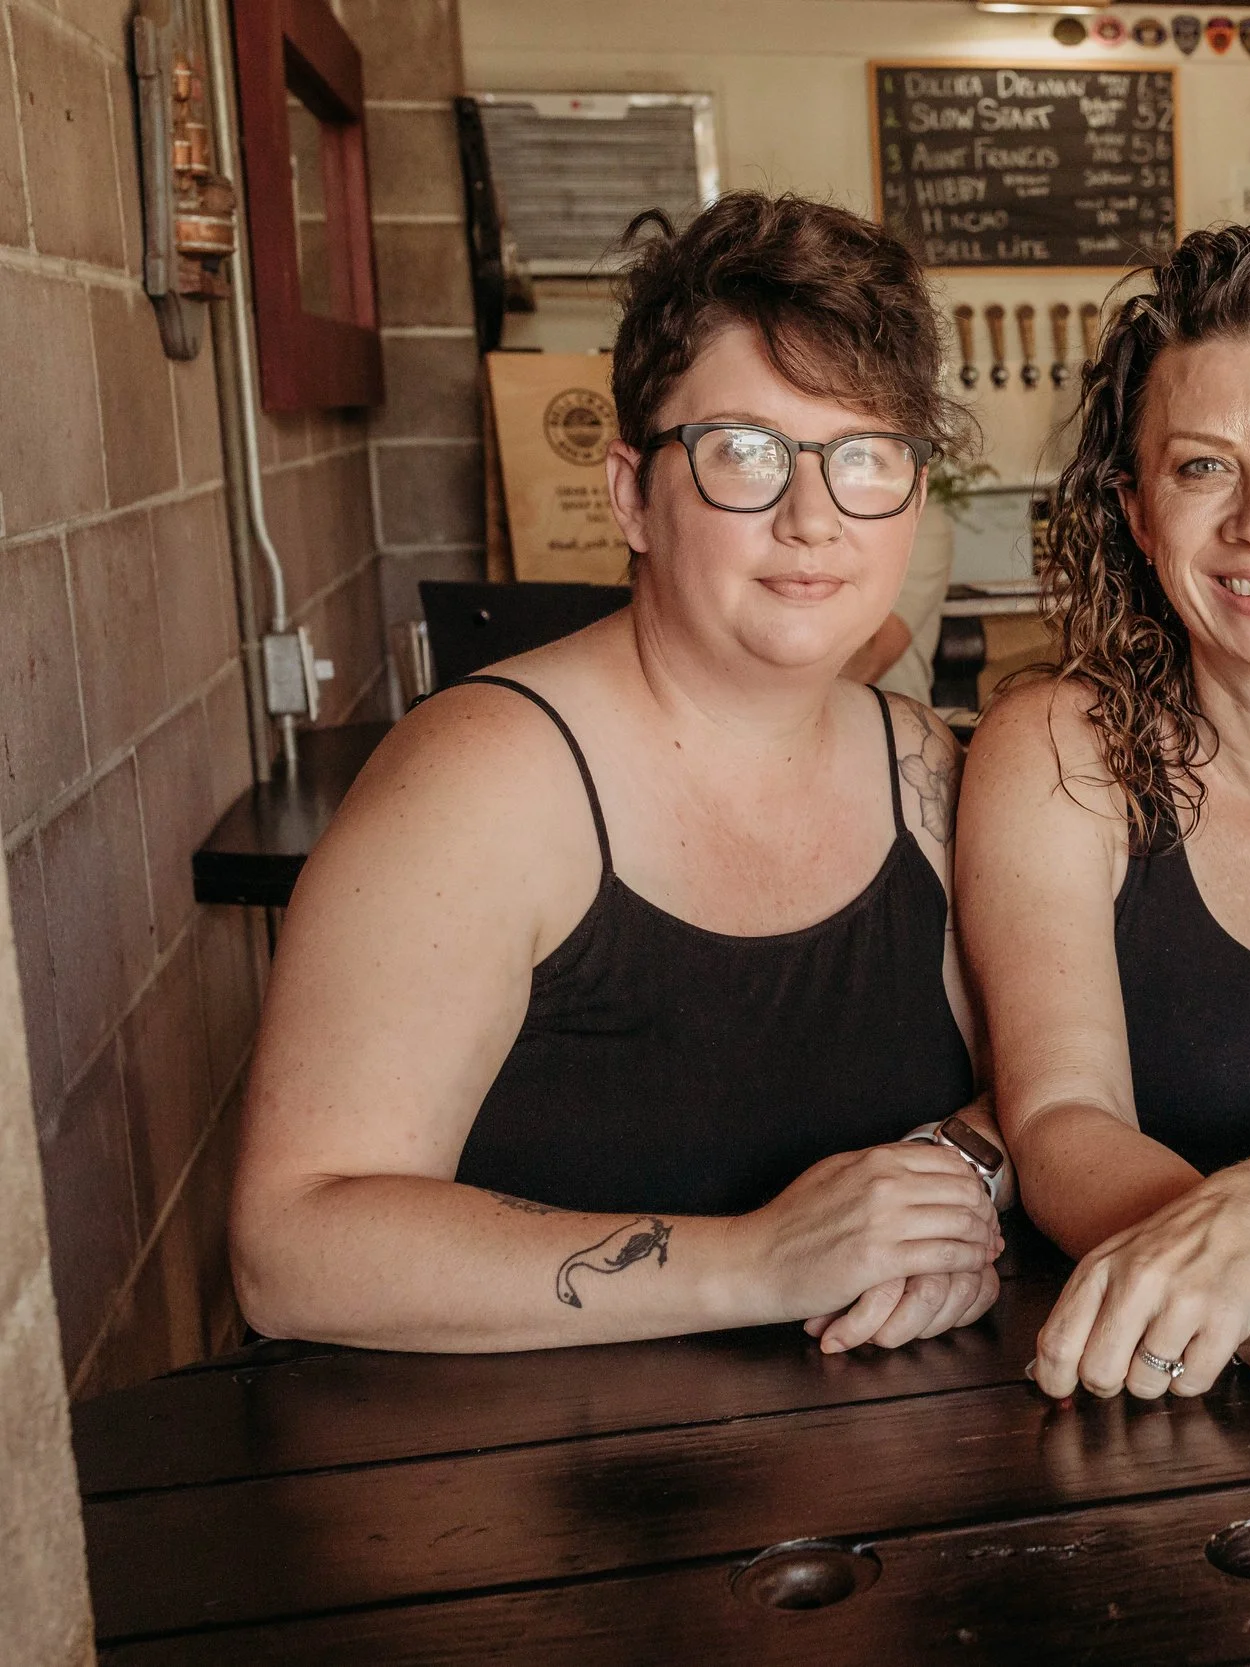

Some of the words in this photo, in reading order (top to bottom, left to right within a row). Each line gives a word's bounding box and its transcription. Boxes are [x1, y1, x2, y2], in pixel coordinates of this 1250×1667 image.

[909, 100, 974, 133] SLOW
[977, 97, 1055, 131] START
[997, 233, 1050, 260] LITE
